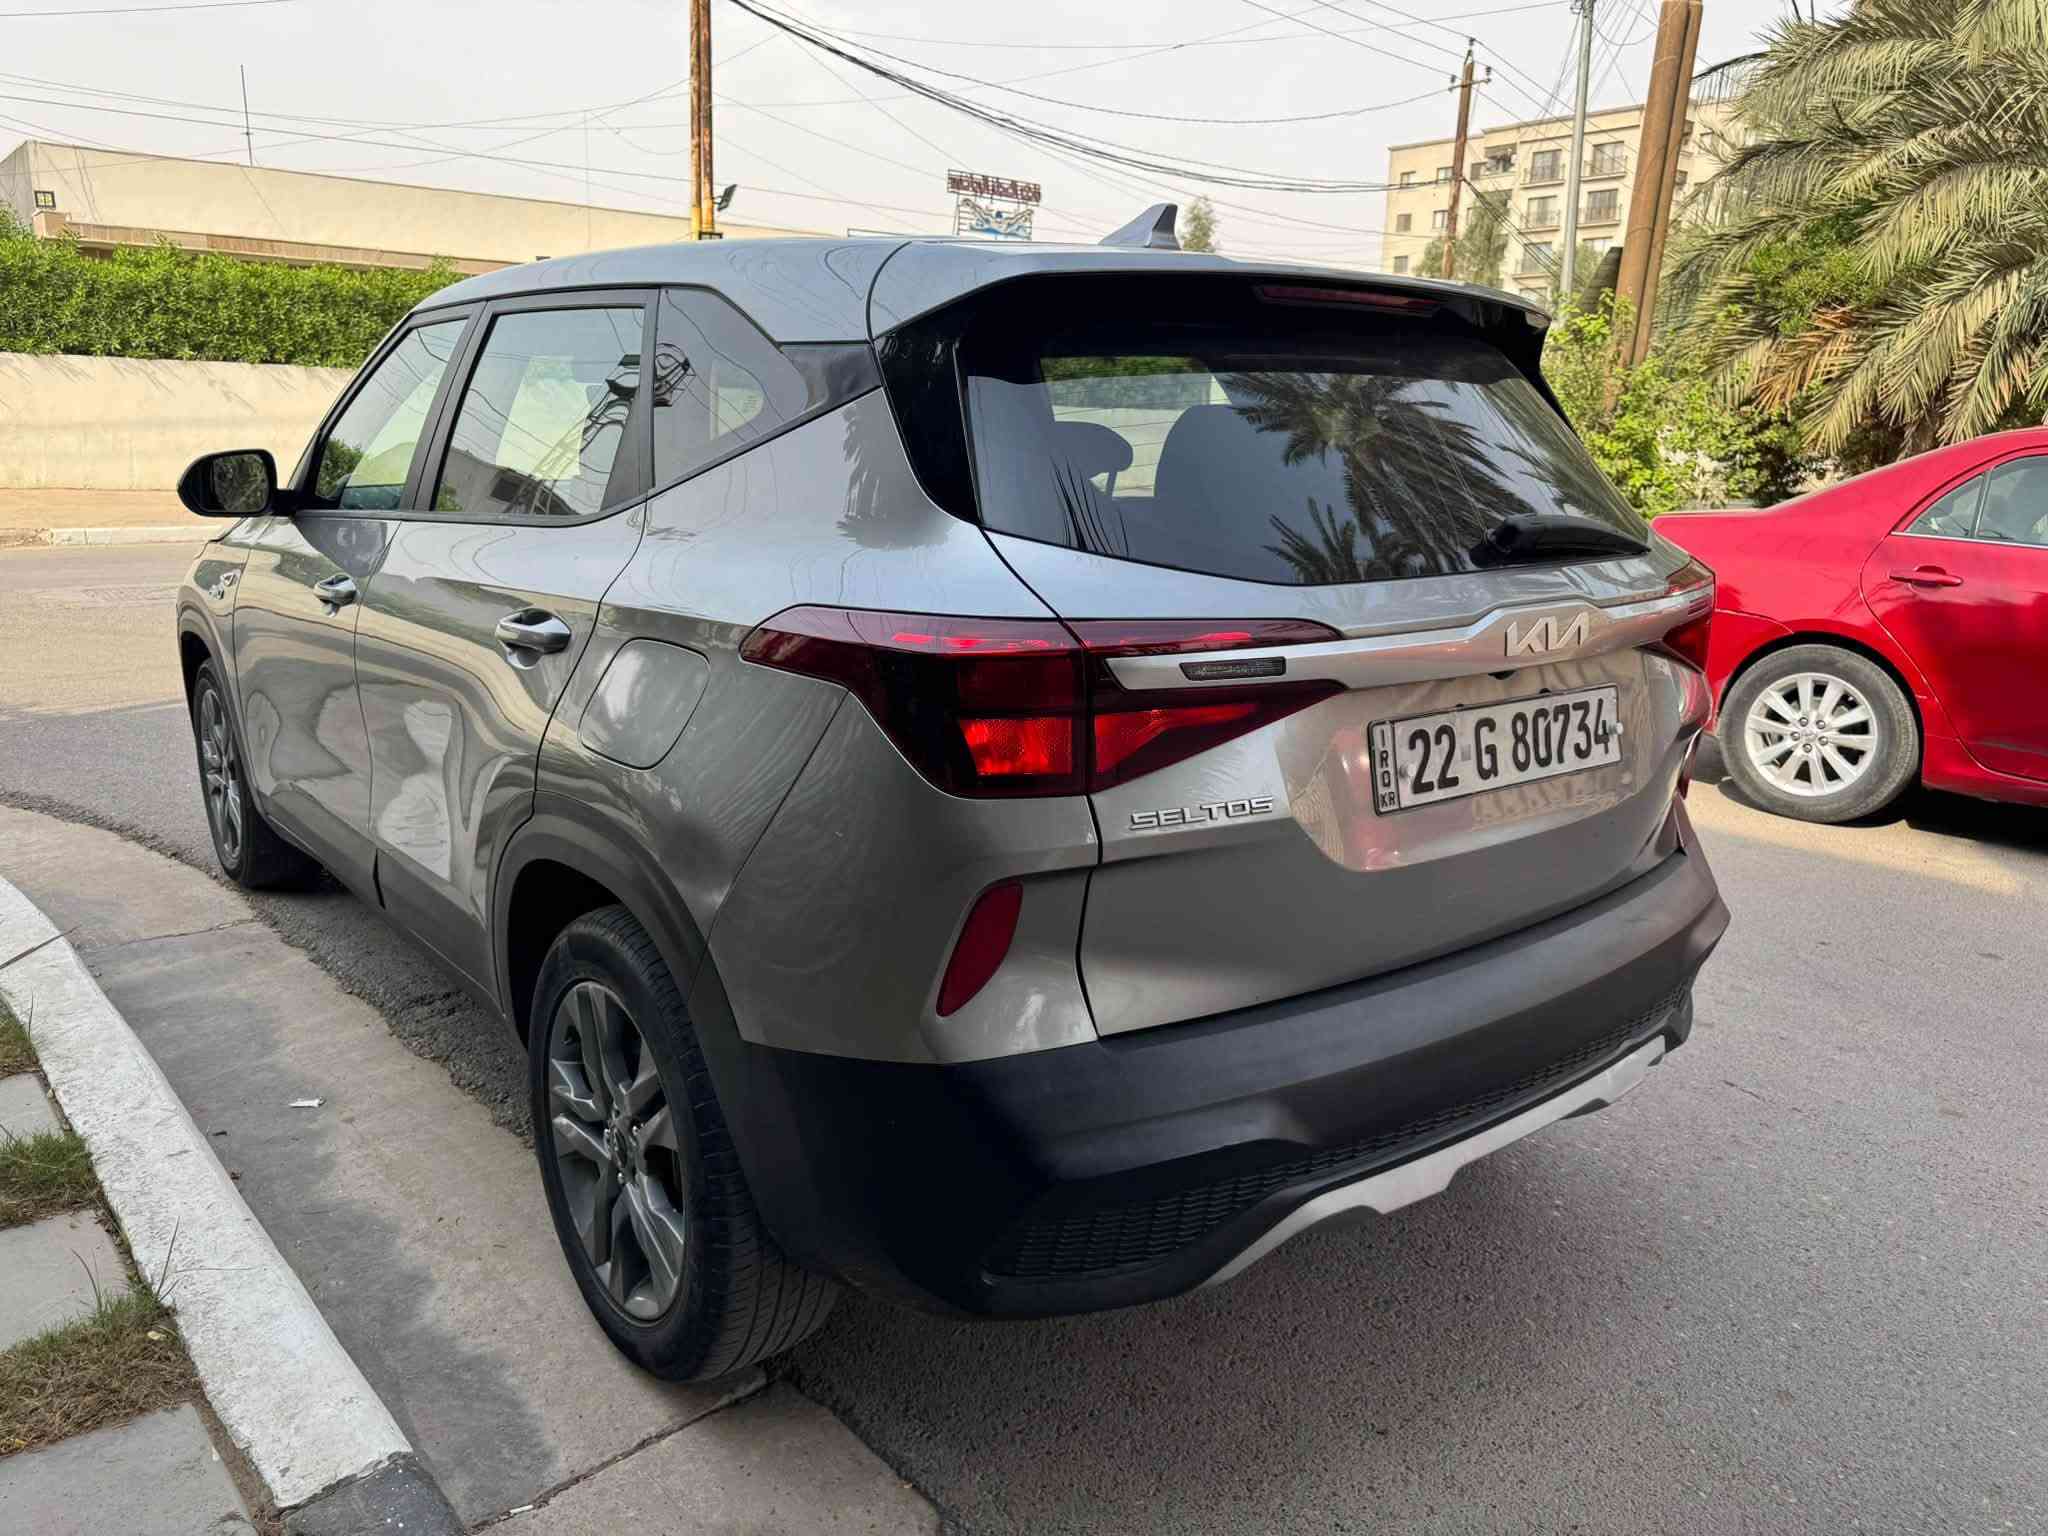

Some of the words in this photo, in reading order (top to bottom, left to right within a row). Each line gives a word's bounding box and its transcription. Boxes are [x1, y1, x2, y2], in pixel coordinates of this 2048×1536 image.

[1505, 612, 1590, 657] KIA
[1408, 724, 1460, 794] 22
[1474, 717, 1500, 781] G
[1511, 698, 1610, 772] 80734
[1130, 795, 1274, 831] SELTOS
